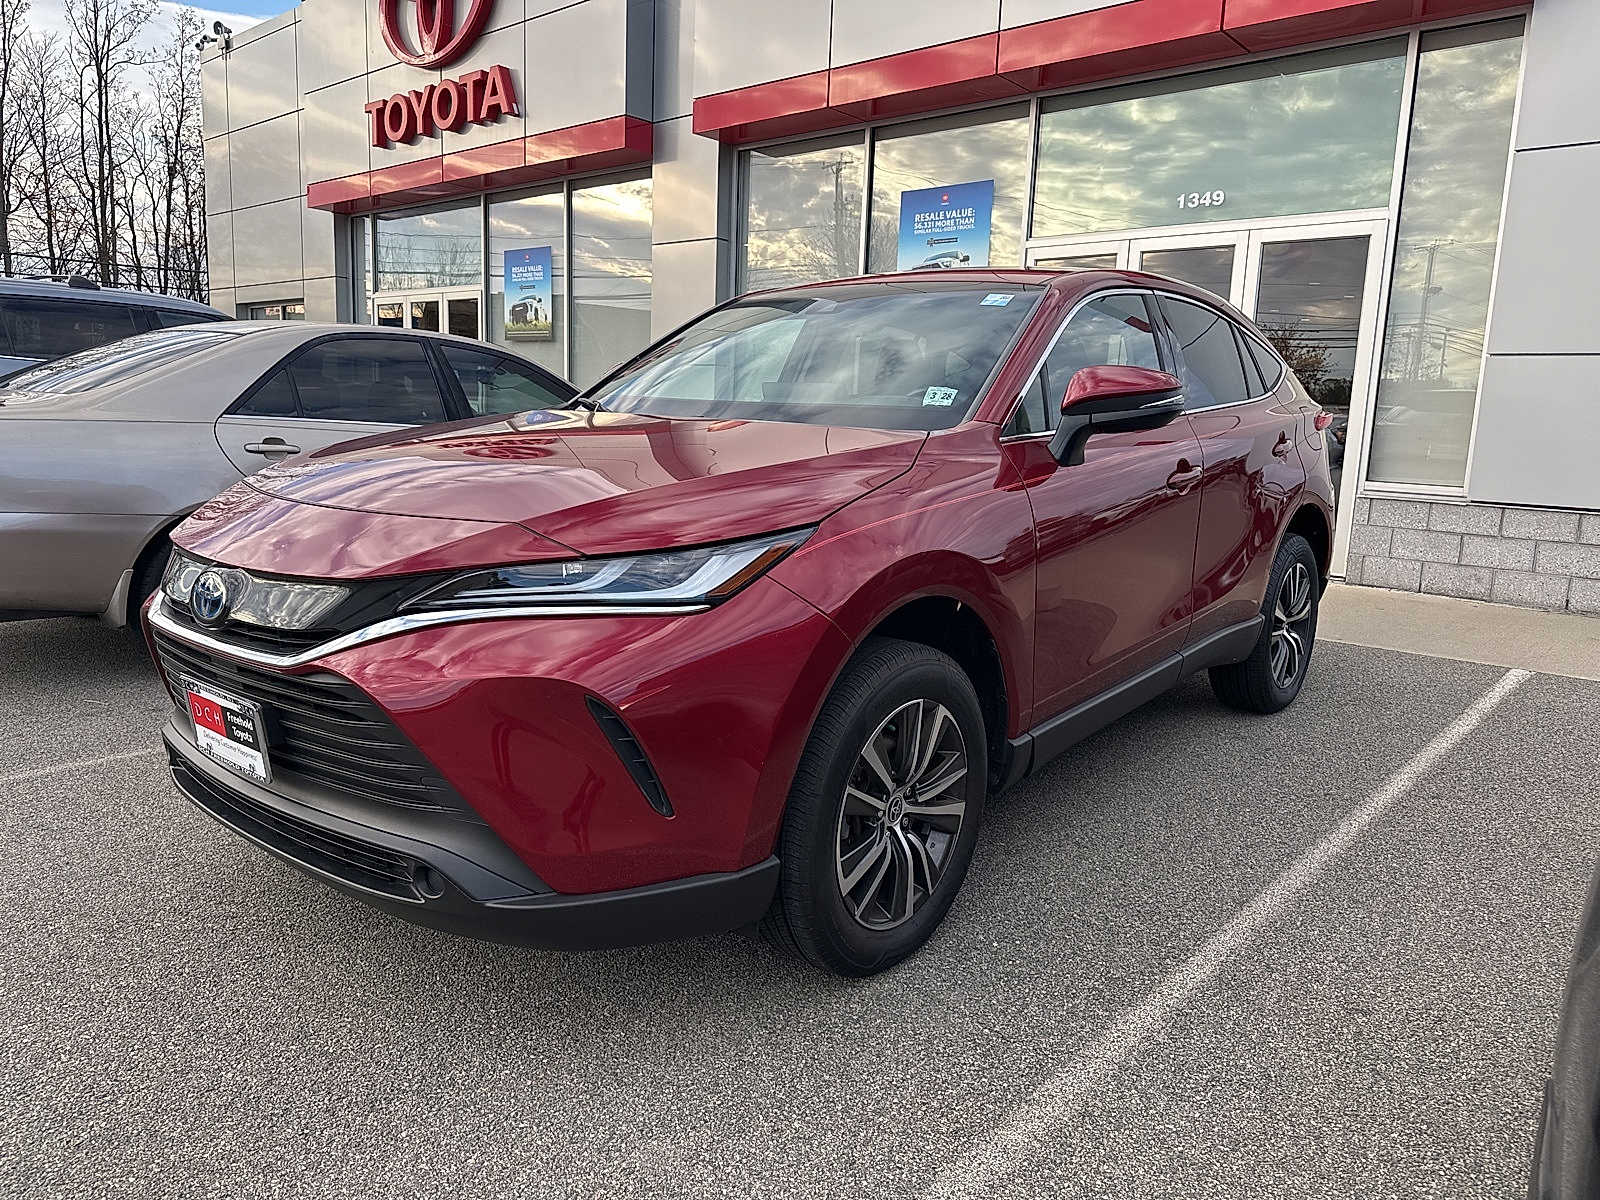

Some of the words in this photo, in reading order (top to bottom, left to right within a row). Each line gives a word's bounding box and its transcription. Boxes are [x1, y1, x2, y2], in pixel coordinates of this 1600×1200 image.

[365, 64, 517, 148] TOYOTA
[1176, 190, 1225, 209] 1349
[914, 211, 944, 222] RESALE
[945, 208, 976, 219] VALUE:
[935, 219, 955, 228] MORE
[956, 217, 975, 225] THAN
[930, 391, 938, 400] 3
[941, 392, 953, 400] 28
[226, 711, 254, 731] Freehold
[231, 726, 254, 743] Toyota
